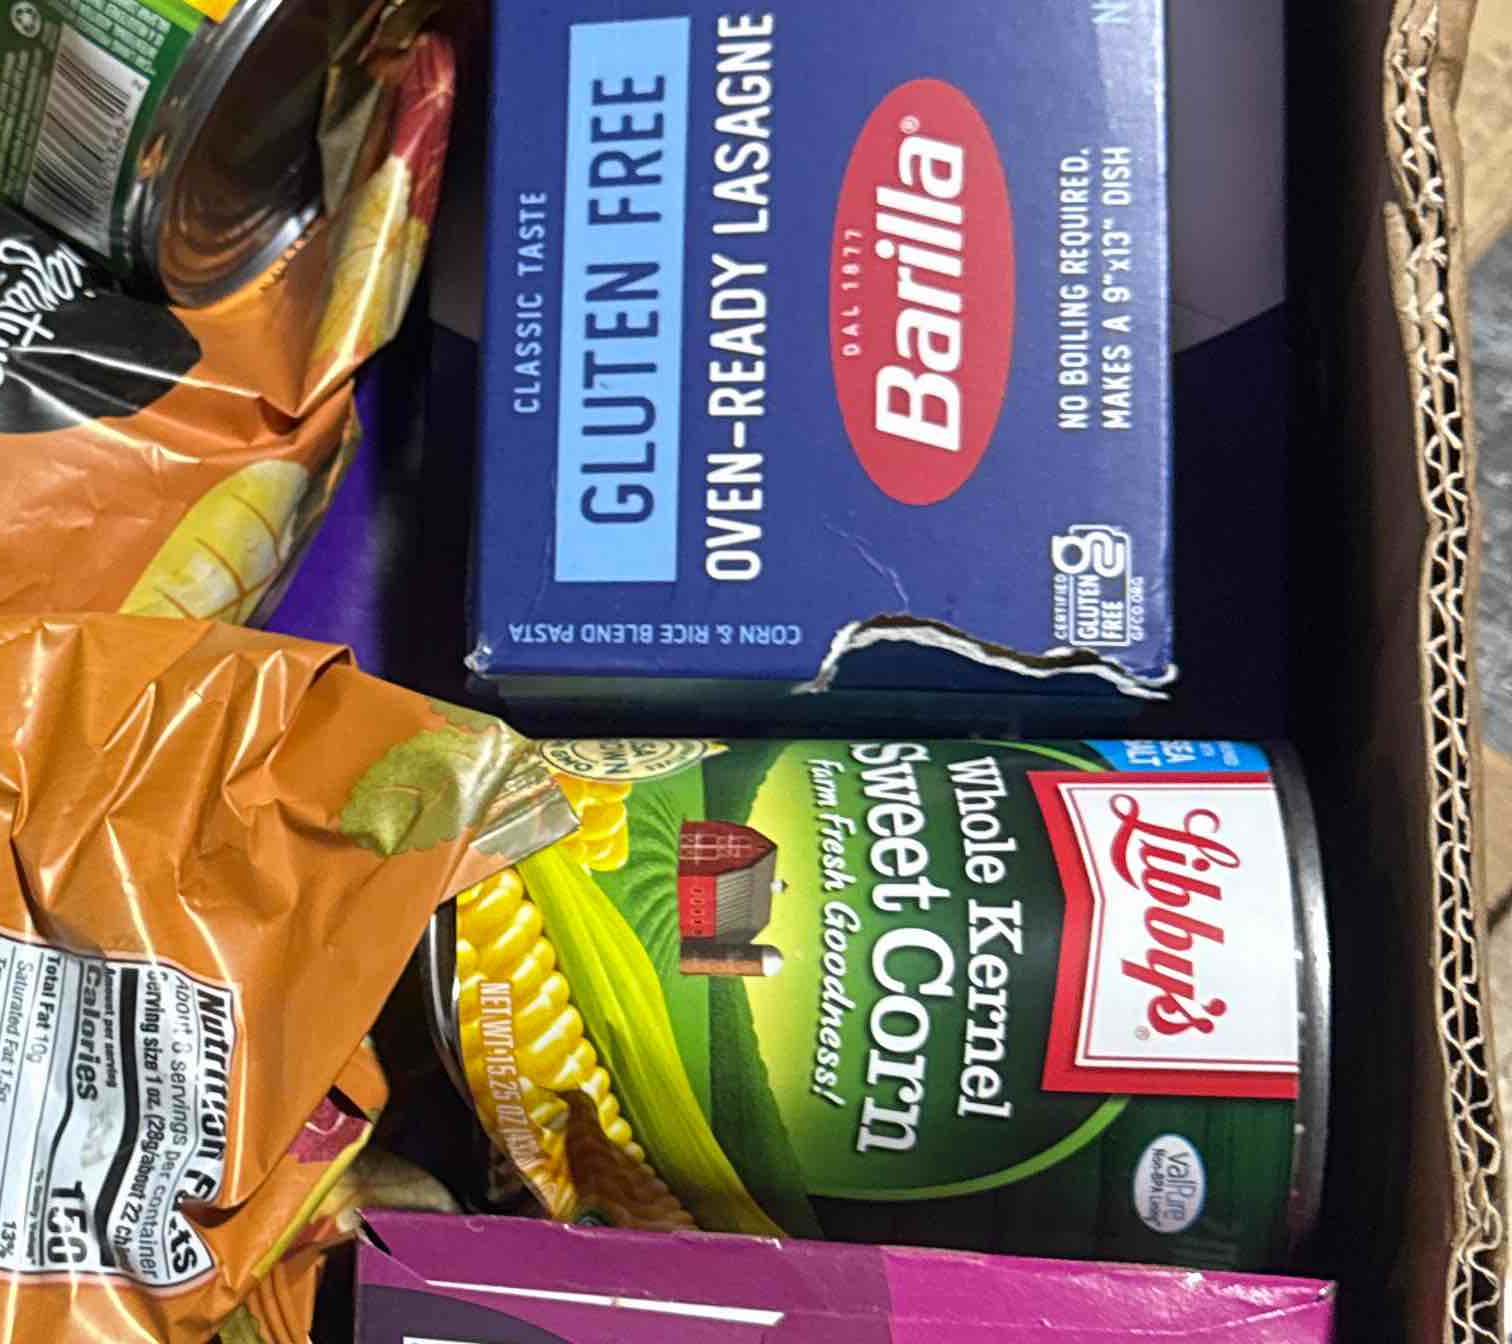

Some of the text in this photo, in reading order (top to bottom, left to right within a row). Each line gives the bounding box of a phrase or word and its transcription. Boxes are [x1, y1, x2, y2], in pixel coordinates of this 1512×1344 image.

[1103, 145, 1131, 208] DISH
[513, 189, 548, 415] CLASSIC TASTE
[579, 73, 666, 526] GLUTEN FREE
[706, 10, 776, 582] OVEN-READY LASAGNE
[842, 228, 865, 357] DAL 1877
[875, 135, 965, 452] Barilla
[1058, 147, 1091, 430] NO BOILING REQUIRED.
[1103, 312, 1131, 335] A
[1103, 343, 1131, 430] MAKES
[509, 621, 801, 644] CORN & RICE BLEND PASTA
[1074, 574, 1099, 639] GLUTEN
[1100, 600, 1123, 639] FREE
[819, 812, 845, 894] fresh
[850, 740, 954, 1154] Sweet Corn
[947, 756, 1023, 1120] Whole Kernel
[1108, 793, 1240, 1039] Libby's
[4, 959, 35, 1037] Saturated
[33, 999, 56, 1031] Fat
[39, 953, 64, 997] Total
[810, 901, 862, 1109] Goodness!
[0, 1038, 19, 1066] Fat
[75, 962, 105, 1102] Calories
[140, 1039, 161, 1071] size
